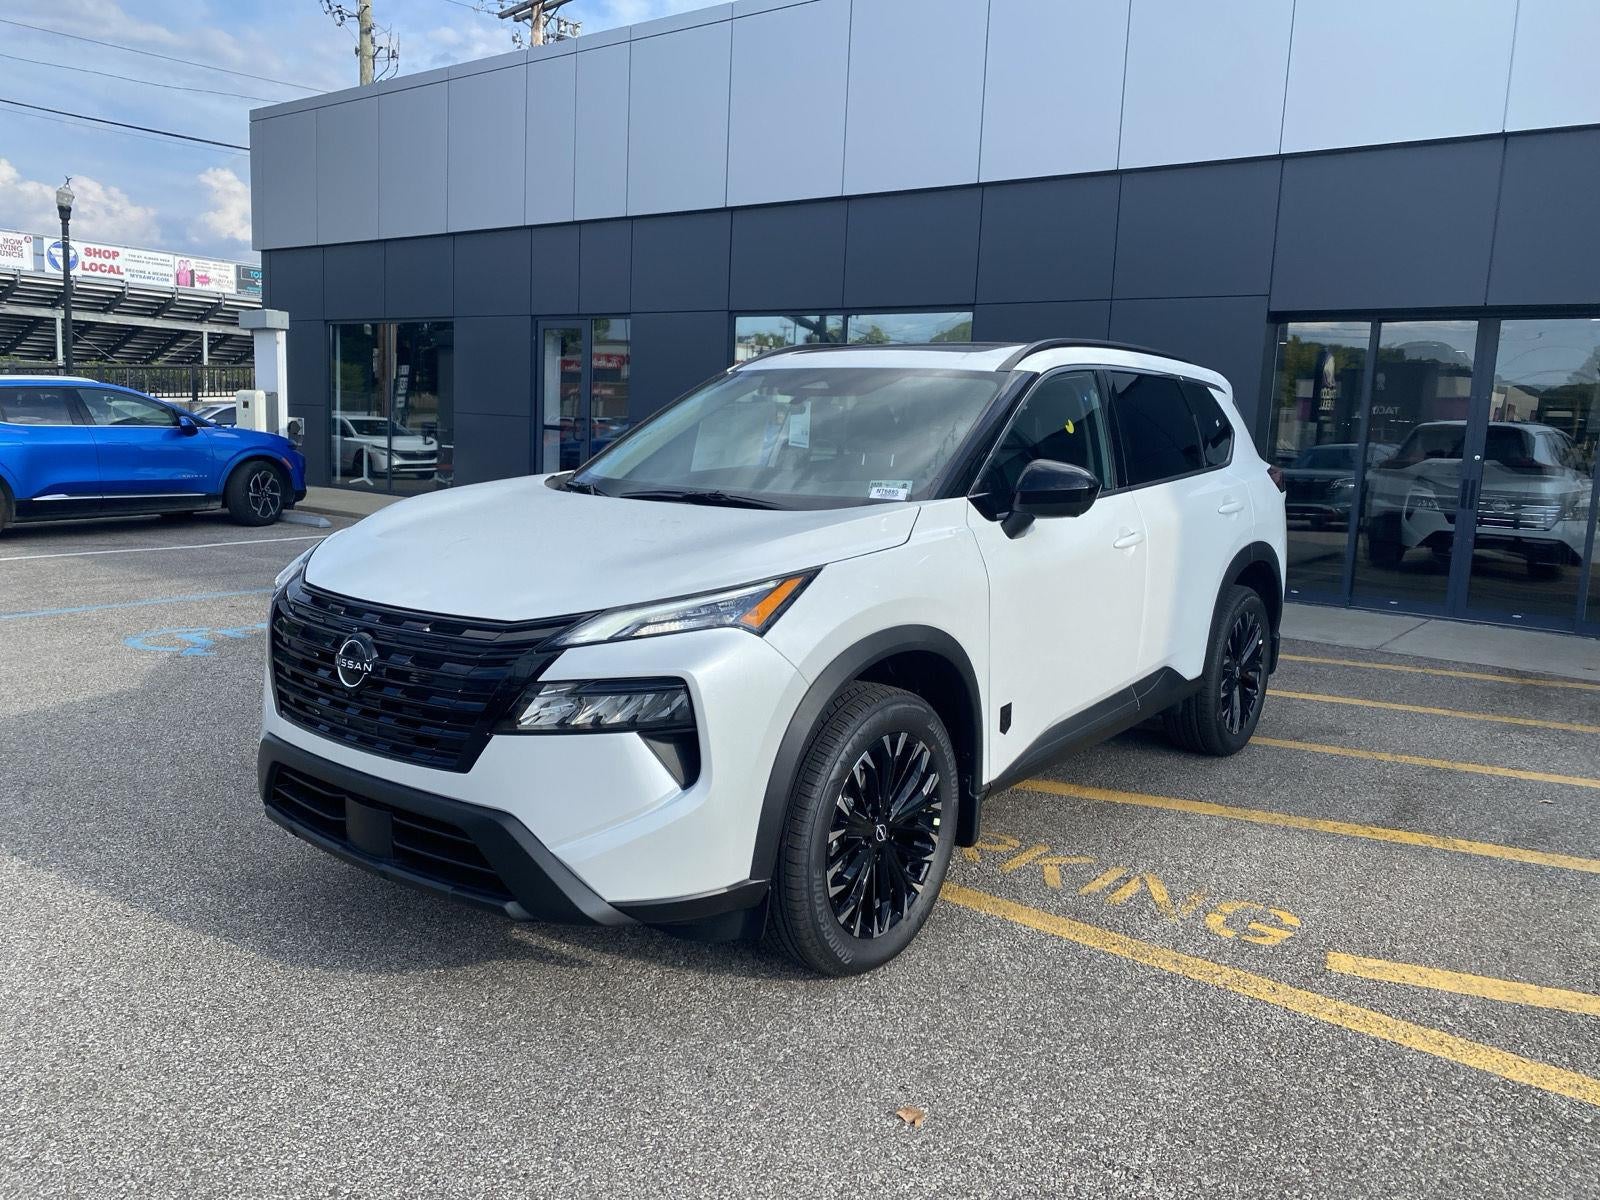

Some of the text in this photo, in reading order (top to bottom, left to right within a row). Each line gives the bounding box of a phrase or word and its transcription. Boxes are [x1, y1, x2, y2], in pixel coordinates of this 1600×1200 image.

[3, 237, 23, 246] NOW
[0, 249, 24, 258] UNCH
[84, 247, 120, 260] SHOP
[82, 261, 124, 275] LOCAL
[336, 656, 373, 672] NISSAN
[963, 831, 1302, 946] RKING
